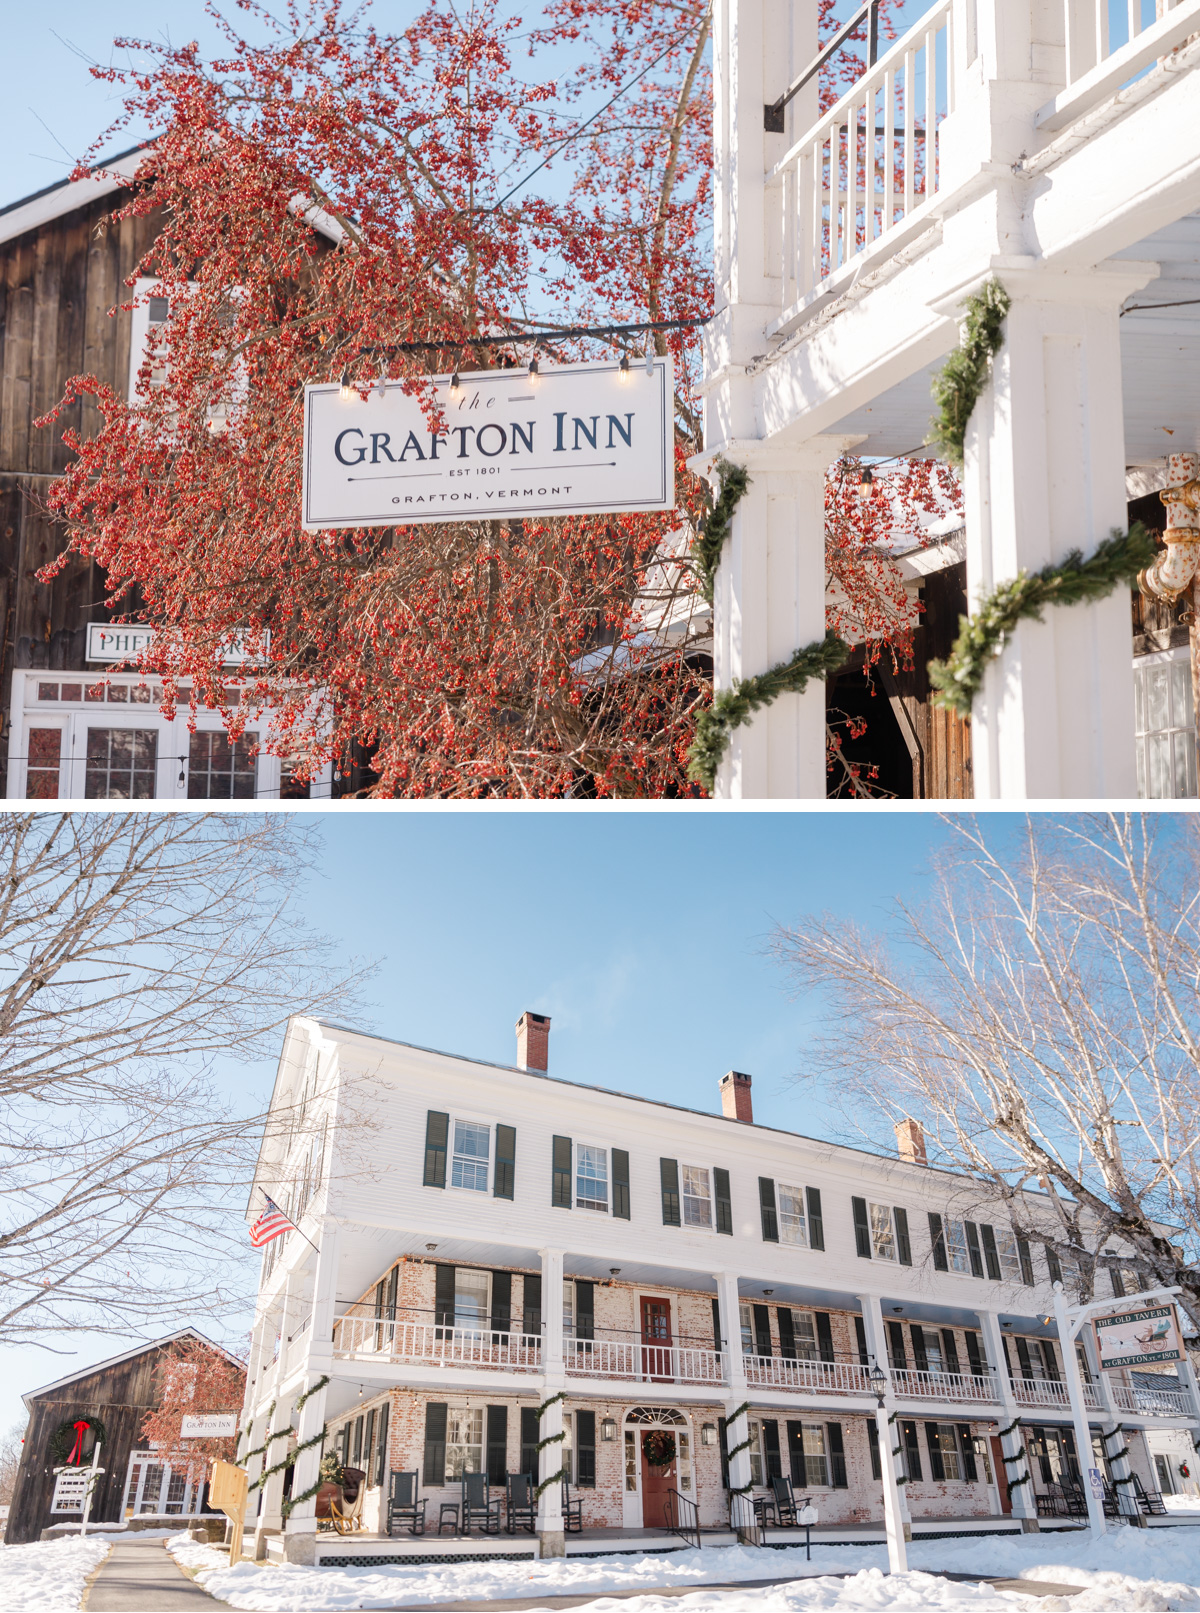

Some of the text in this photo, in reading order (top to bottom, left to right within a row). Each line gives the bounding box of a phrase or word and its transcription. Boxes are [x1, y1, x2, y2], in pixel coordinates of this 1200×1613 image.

[458, 391, 496, 411] the
[334, 411, 636, 466] GRAFTON INN
[449, 466, 501, 477] EST 1801
[391, 486, 574, 505] GRAFTON, VERMONT
[1097, 1308, 1169, 1327] THE OLD TAVERN
[1161, 1351, 1178, 1360] 1801
[218, 1420, 232, 1428] INN
